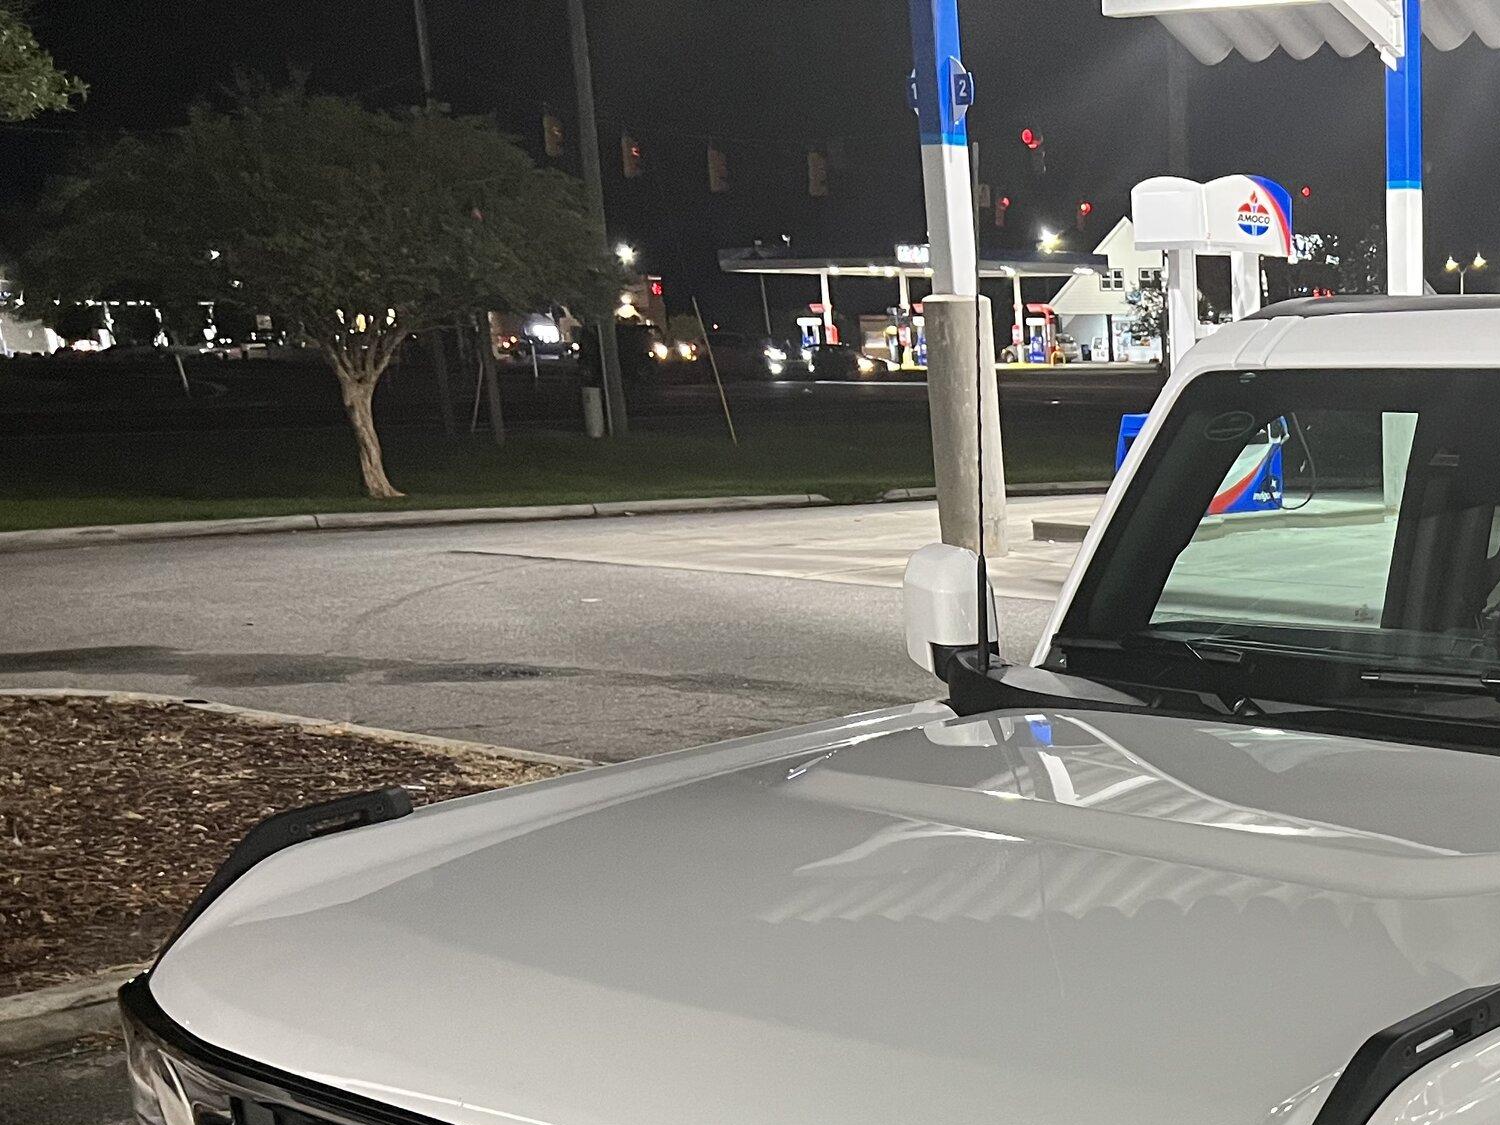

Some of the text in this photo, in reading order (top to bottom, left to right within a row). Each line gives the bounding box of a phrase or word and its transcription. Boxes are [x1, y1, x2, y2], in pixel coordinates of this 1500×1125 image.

[911, 83, 918, 100] 1
[959, 80, 967, 97] 2
[1237, 213, 1270, 225] AMOCO
